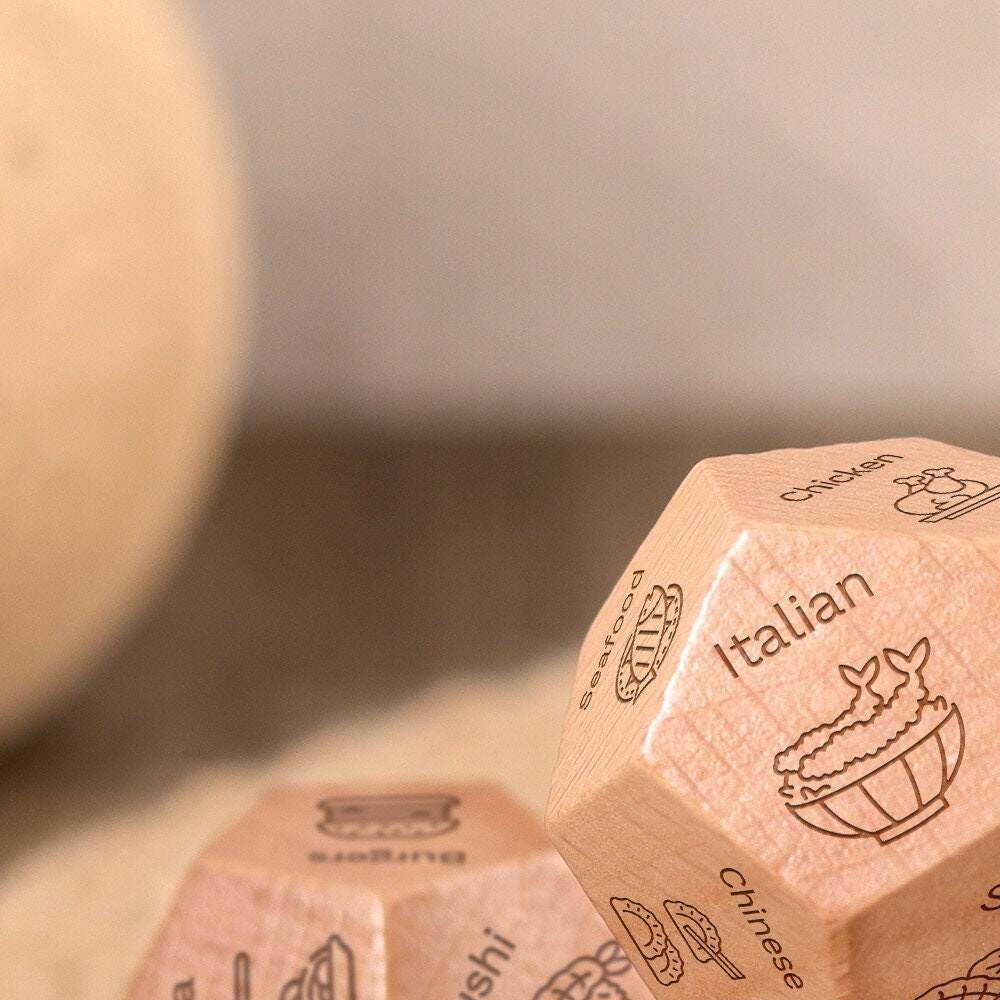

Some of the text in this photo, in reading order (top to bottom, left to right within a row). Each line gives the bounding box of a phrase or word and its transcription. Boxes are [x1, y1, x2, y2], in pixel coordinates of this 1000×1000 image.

[779, 454, 903, 502] Chicken
[579, 570, 644, 711] Seafood
[713, 573, 874, 679] Italian
[720, 866, 804, 990] Chinese
